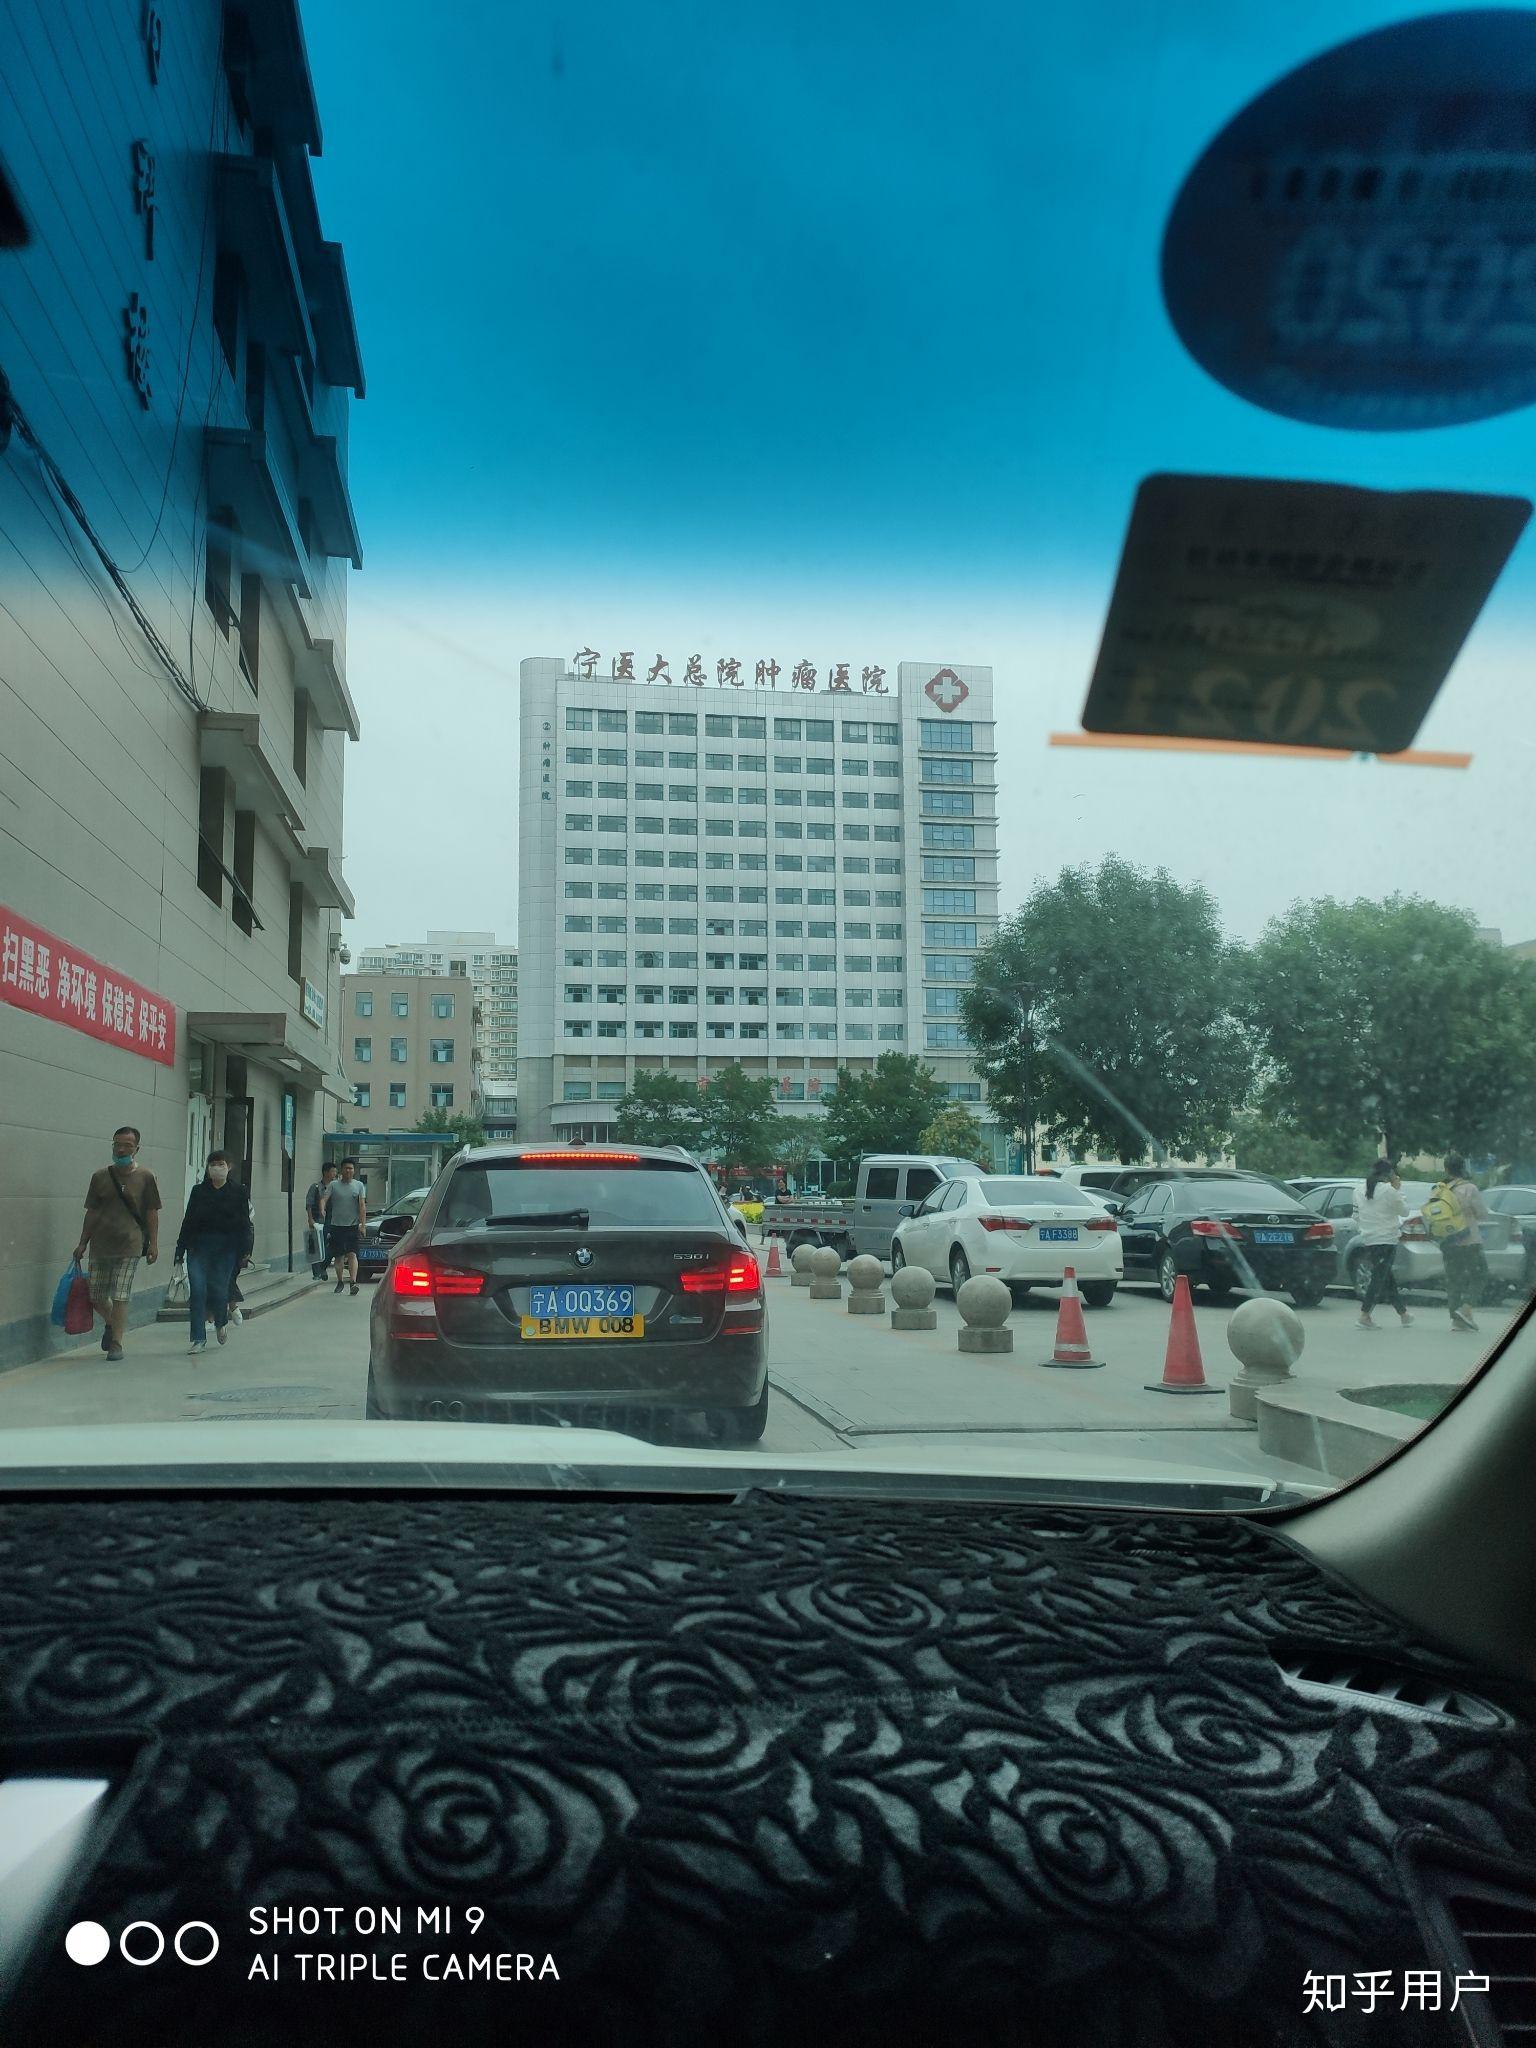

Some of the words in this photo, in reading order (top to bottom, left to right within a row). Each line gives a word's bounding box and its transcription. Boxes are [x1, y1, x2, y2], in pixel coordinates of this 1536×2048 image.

[572, 645, 890, 695] 宁医大总院肿瘤医院
[2, 925, 50, 999] 扫黑恶
[57, 956, 97, 1021] 净环境
[102, 978, 135, 1037] 保稳定
[139, 998, 167, 1050] 保平安
[539, 1318, 590, 1335] BMW
[599, 1318, 634, 1334] 008
